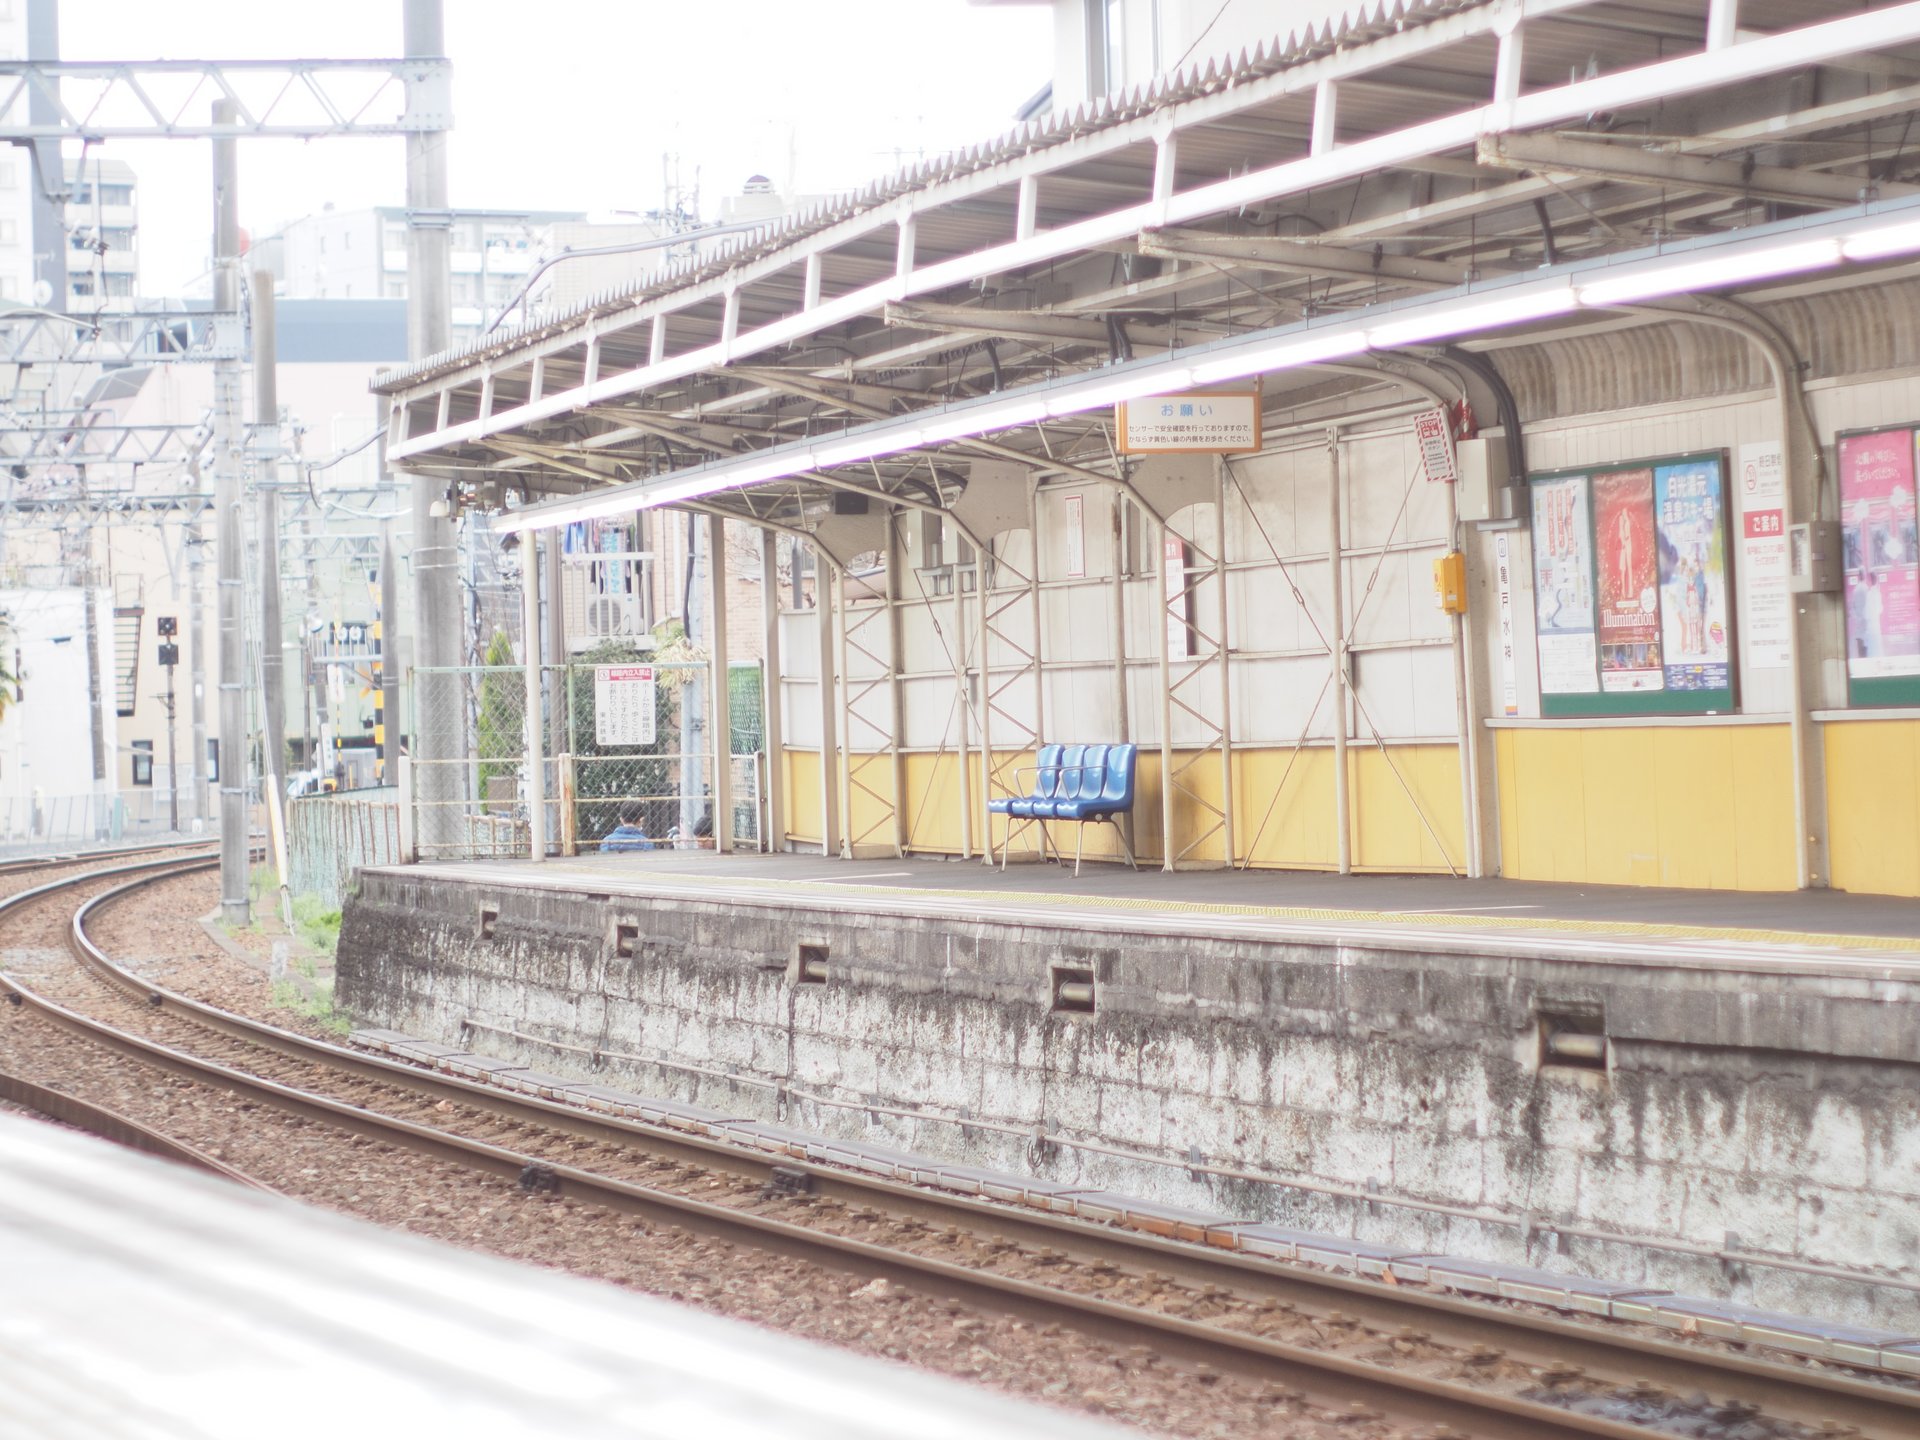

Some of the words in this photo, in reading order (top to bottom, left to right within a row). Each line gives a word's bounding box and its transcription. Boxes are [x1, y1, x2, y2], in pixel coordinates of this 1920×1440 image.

[1160, 403, 1213, 417] お願い
[1420, 419, 1437, 428] STOP
[1668, 474, 1707, 498] 日光湯元
[1752, 514, 1779, 532] ご案内
[1603, 608, 1655, 628] Illumination
